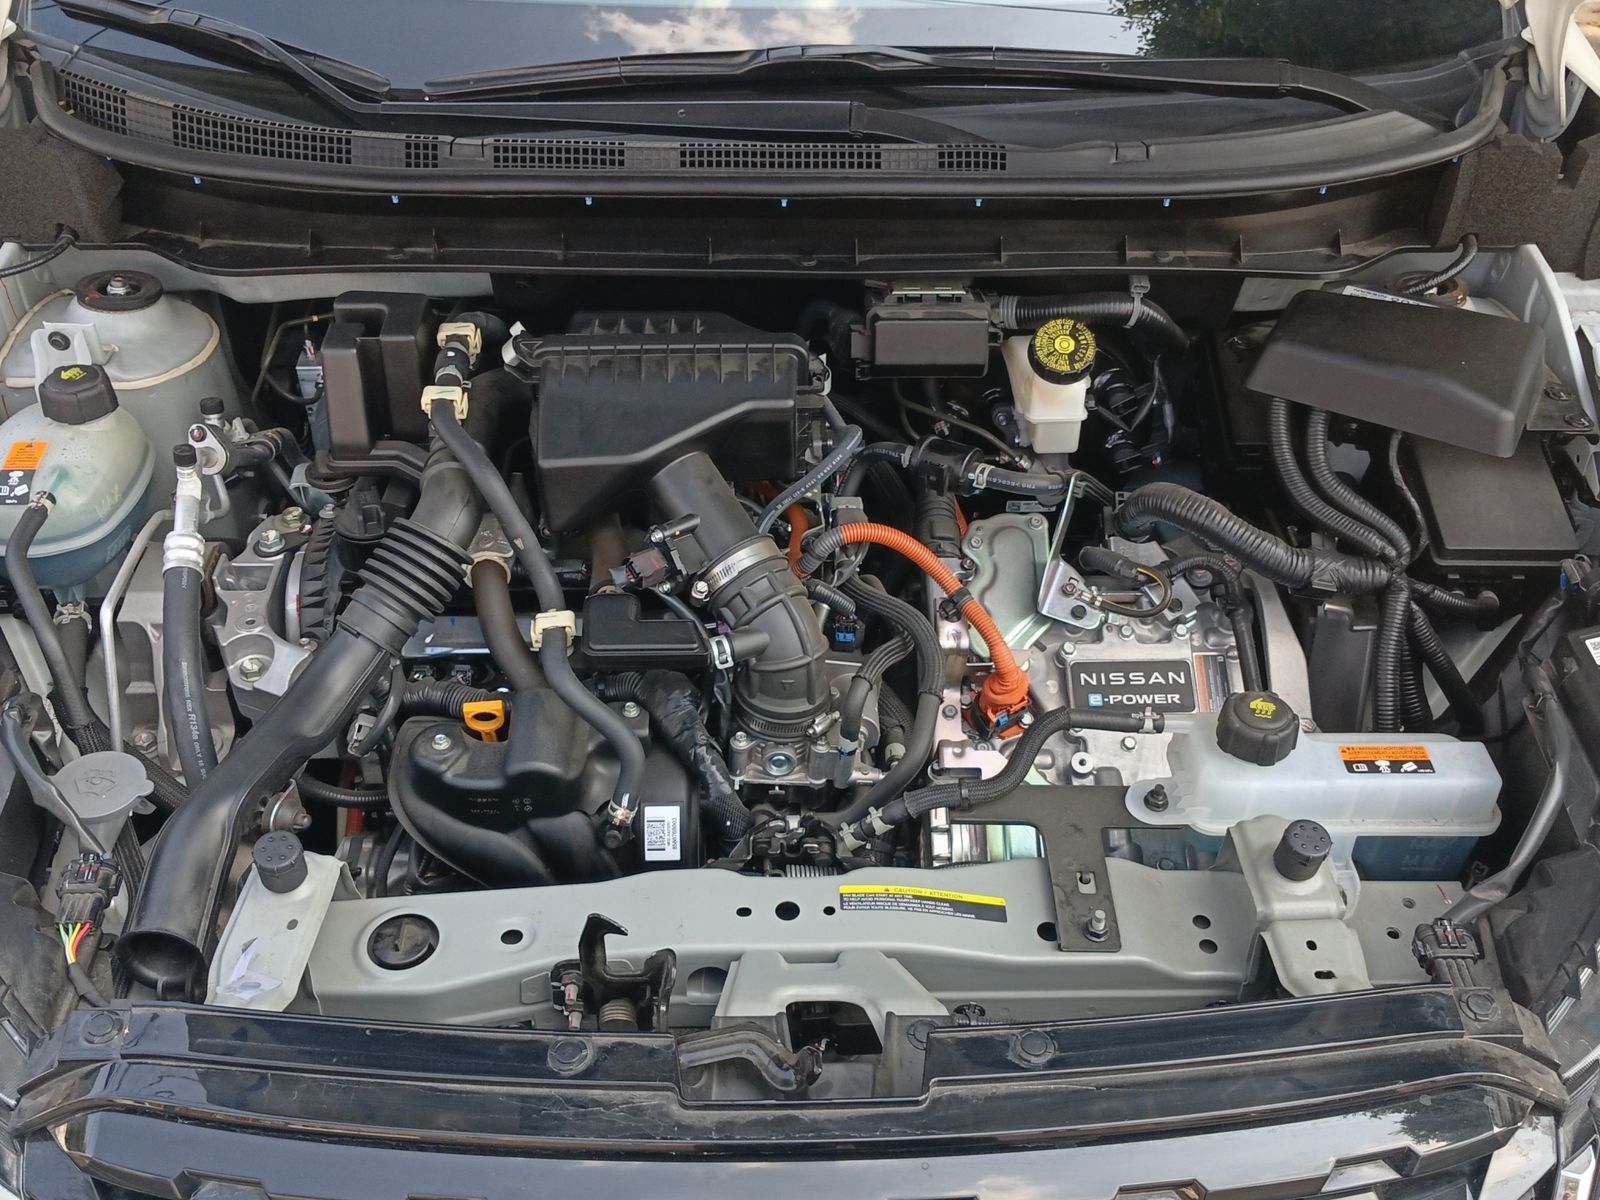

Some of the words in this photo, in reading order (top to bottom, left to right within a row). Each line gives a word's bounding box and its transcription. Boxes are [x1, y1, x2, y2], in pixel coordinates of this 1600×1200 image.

[1080, 672, 1185, 686] NISSAN
[1088, 693, 1181, 706] e-POWER
[188, 713, 200, 740] R134a
[930, 891, 963, 899] ATTENTION
